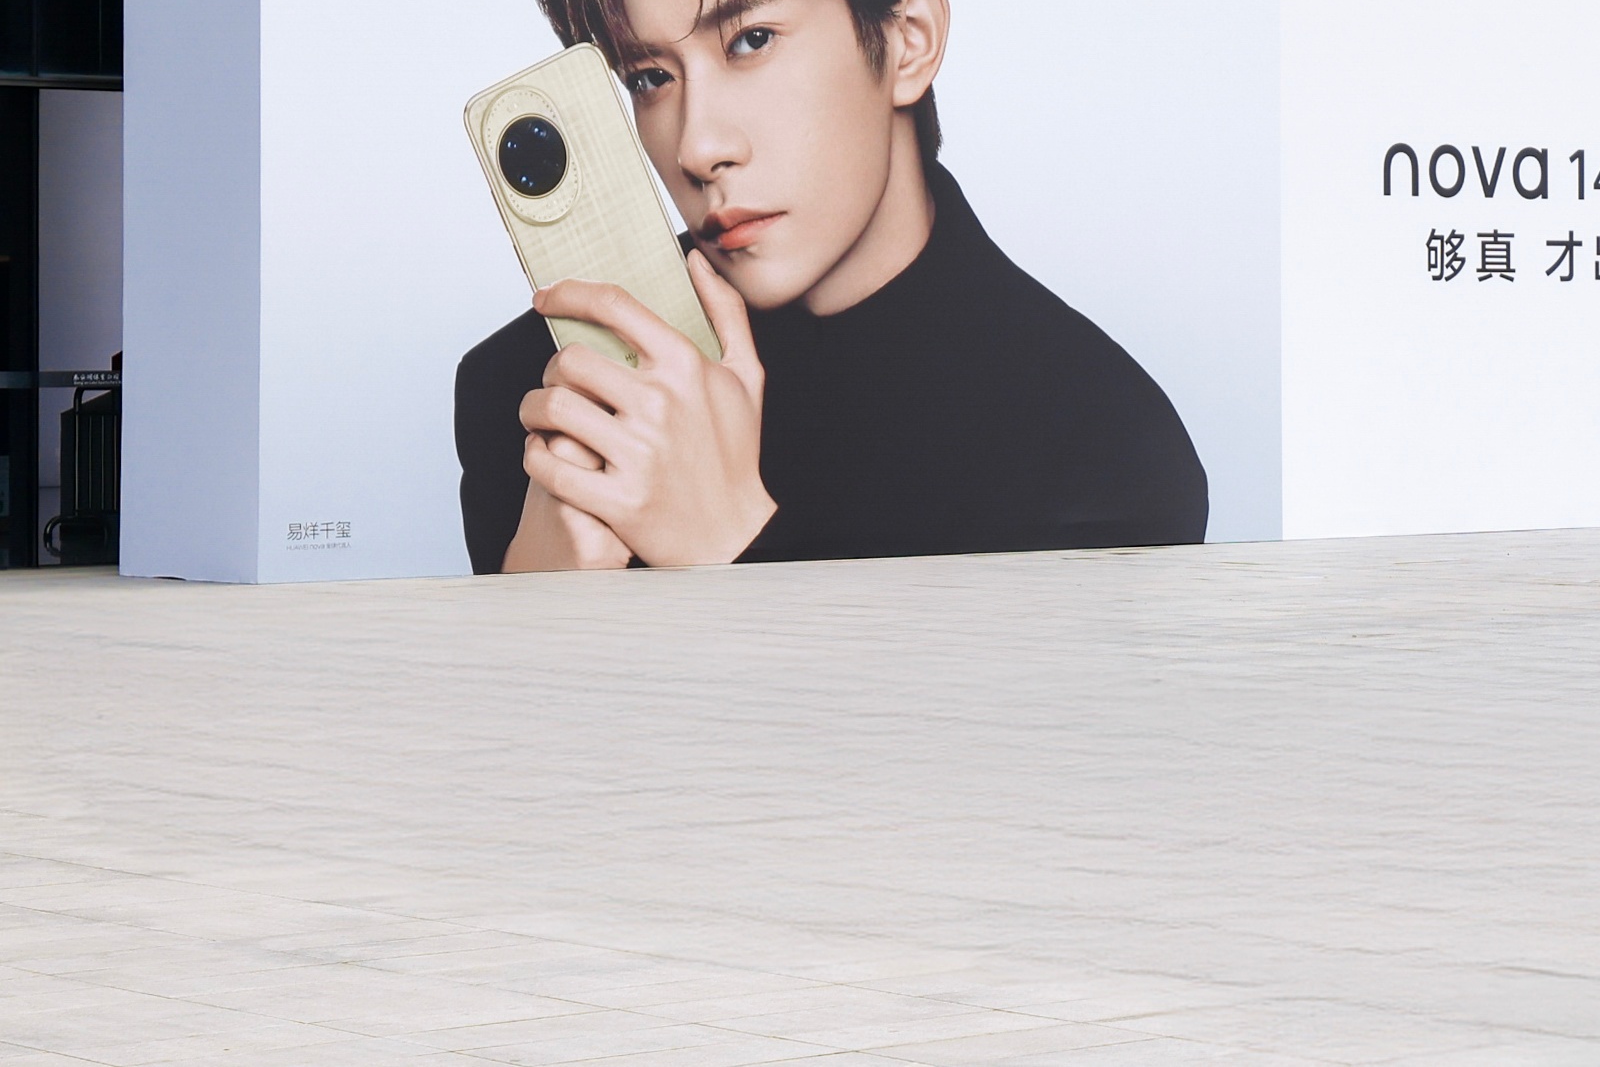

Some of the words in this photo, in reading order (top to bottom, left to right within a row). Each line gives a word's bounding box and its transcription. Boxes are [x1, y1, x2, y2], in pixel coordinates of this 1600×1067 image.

[1383, 142, 1549, 200] nova
[1425, 228, 1517, 283] 够真
[286, 520, 352, 541] 易烊千玺
